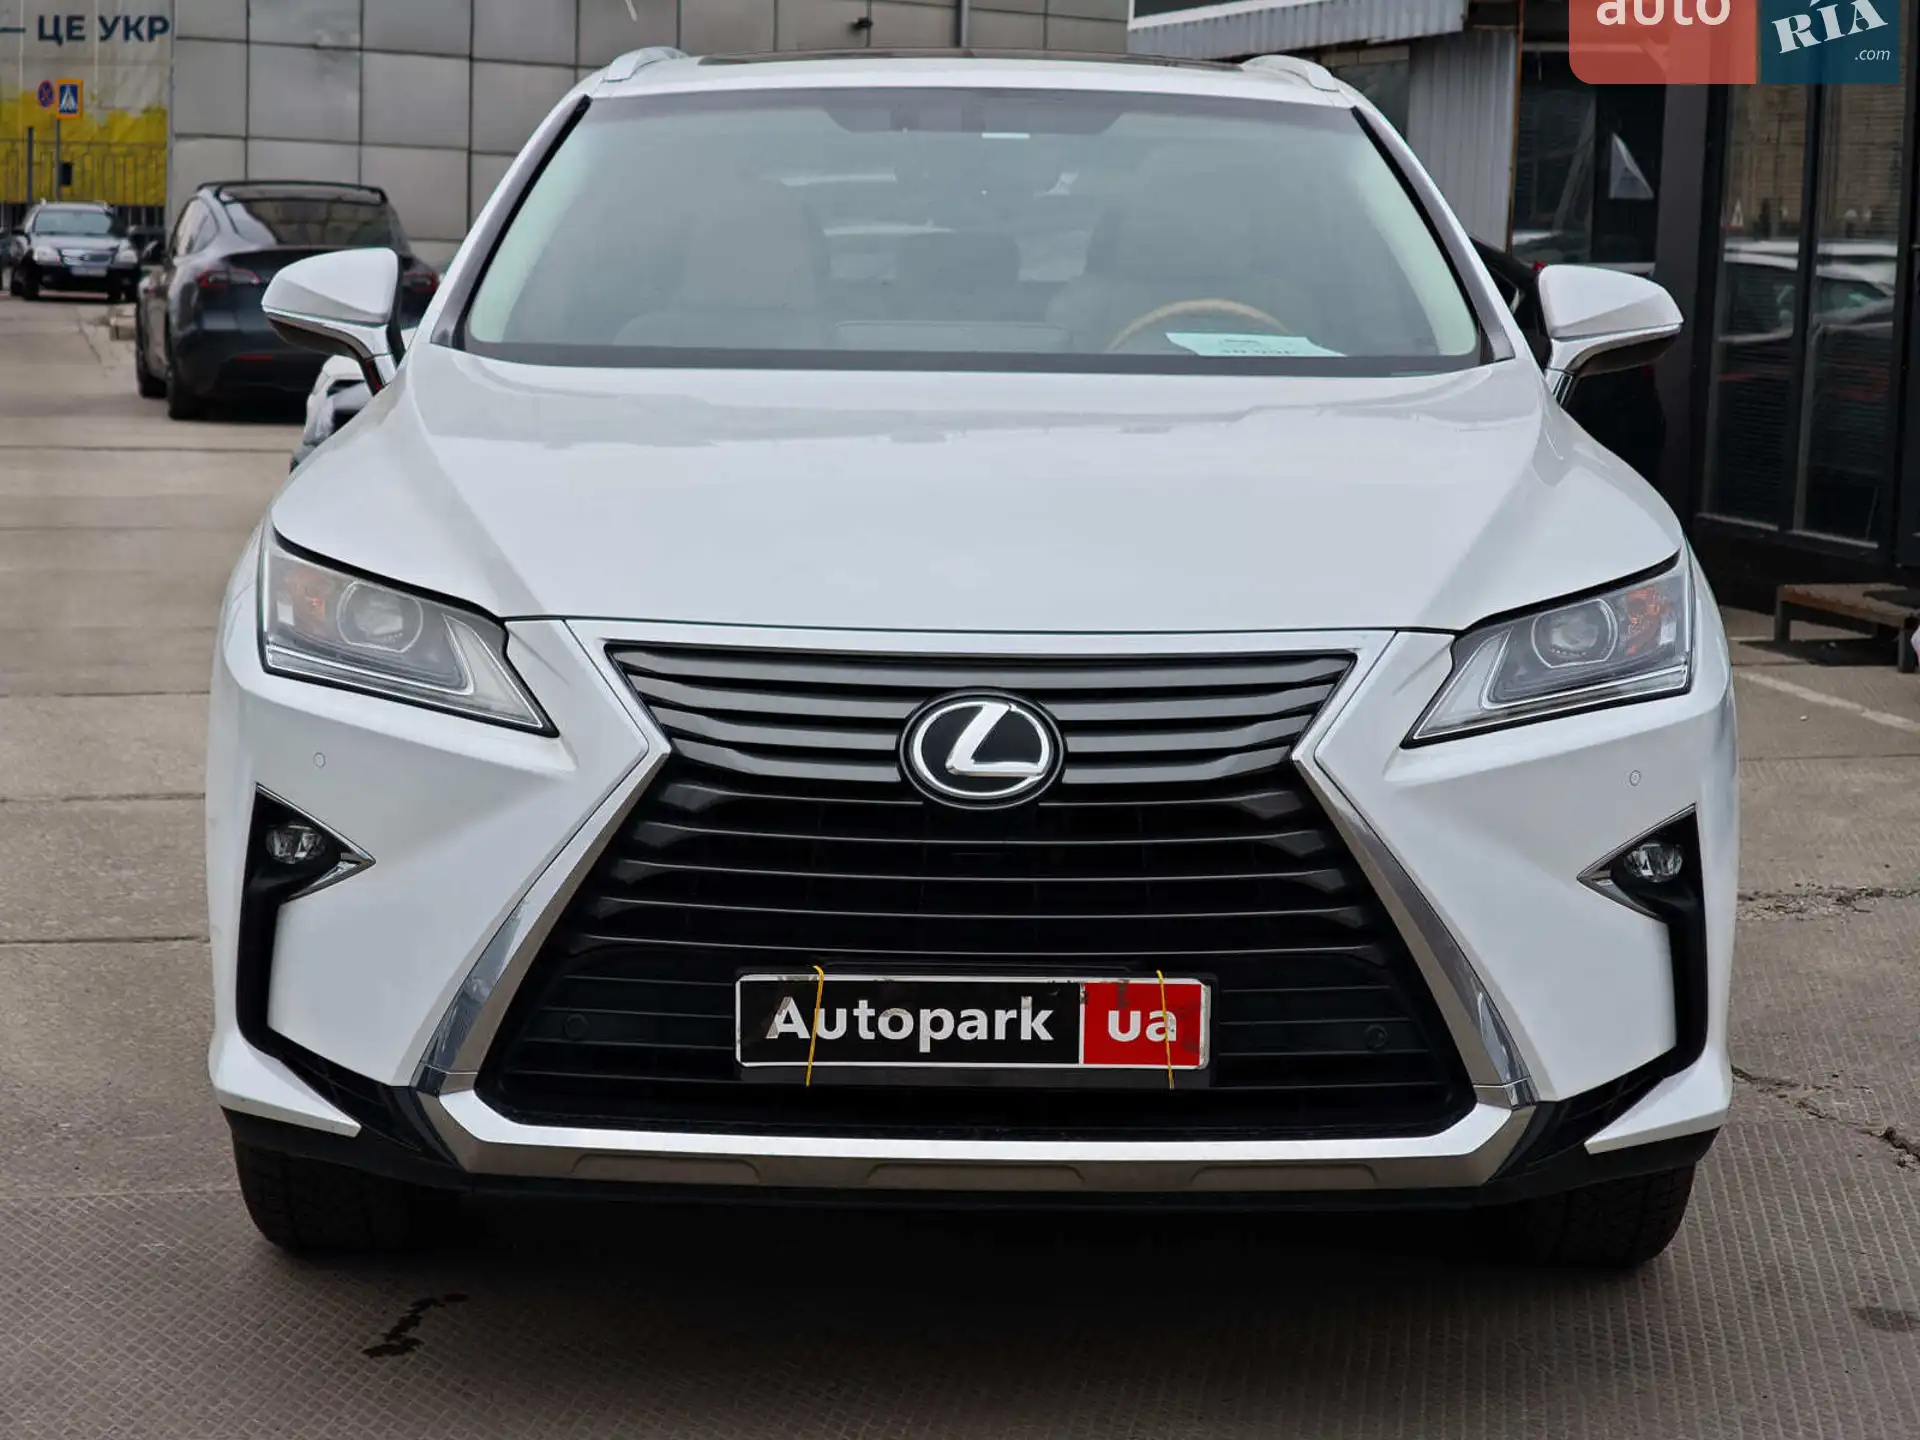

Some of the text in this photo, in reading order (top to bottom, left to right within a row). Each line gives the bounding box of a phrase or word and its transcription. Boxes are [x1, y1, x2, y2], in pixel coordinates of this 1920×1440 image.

[38, 15, 86, 46] ЦЕ
[98, 15, 170, 42] УКР
[766, 996, 1178, 1053] Autopark ua
